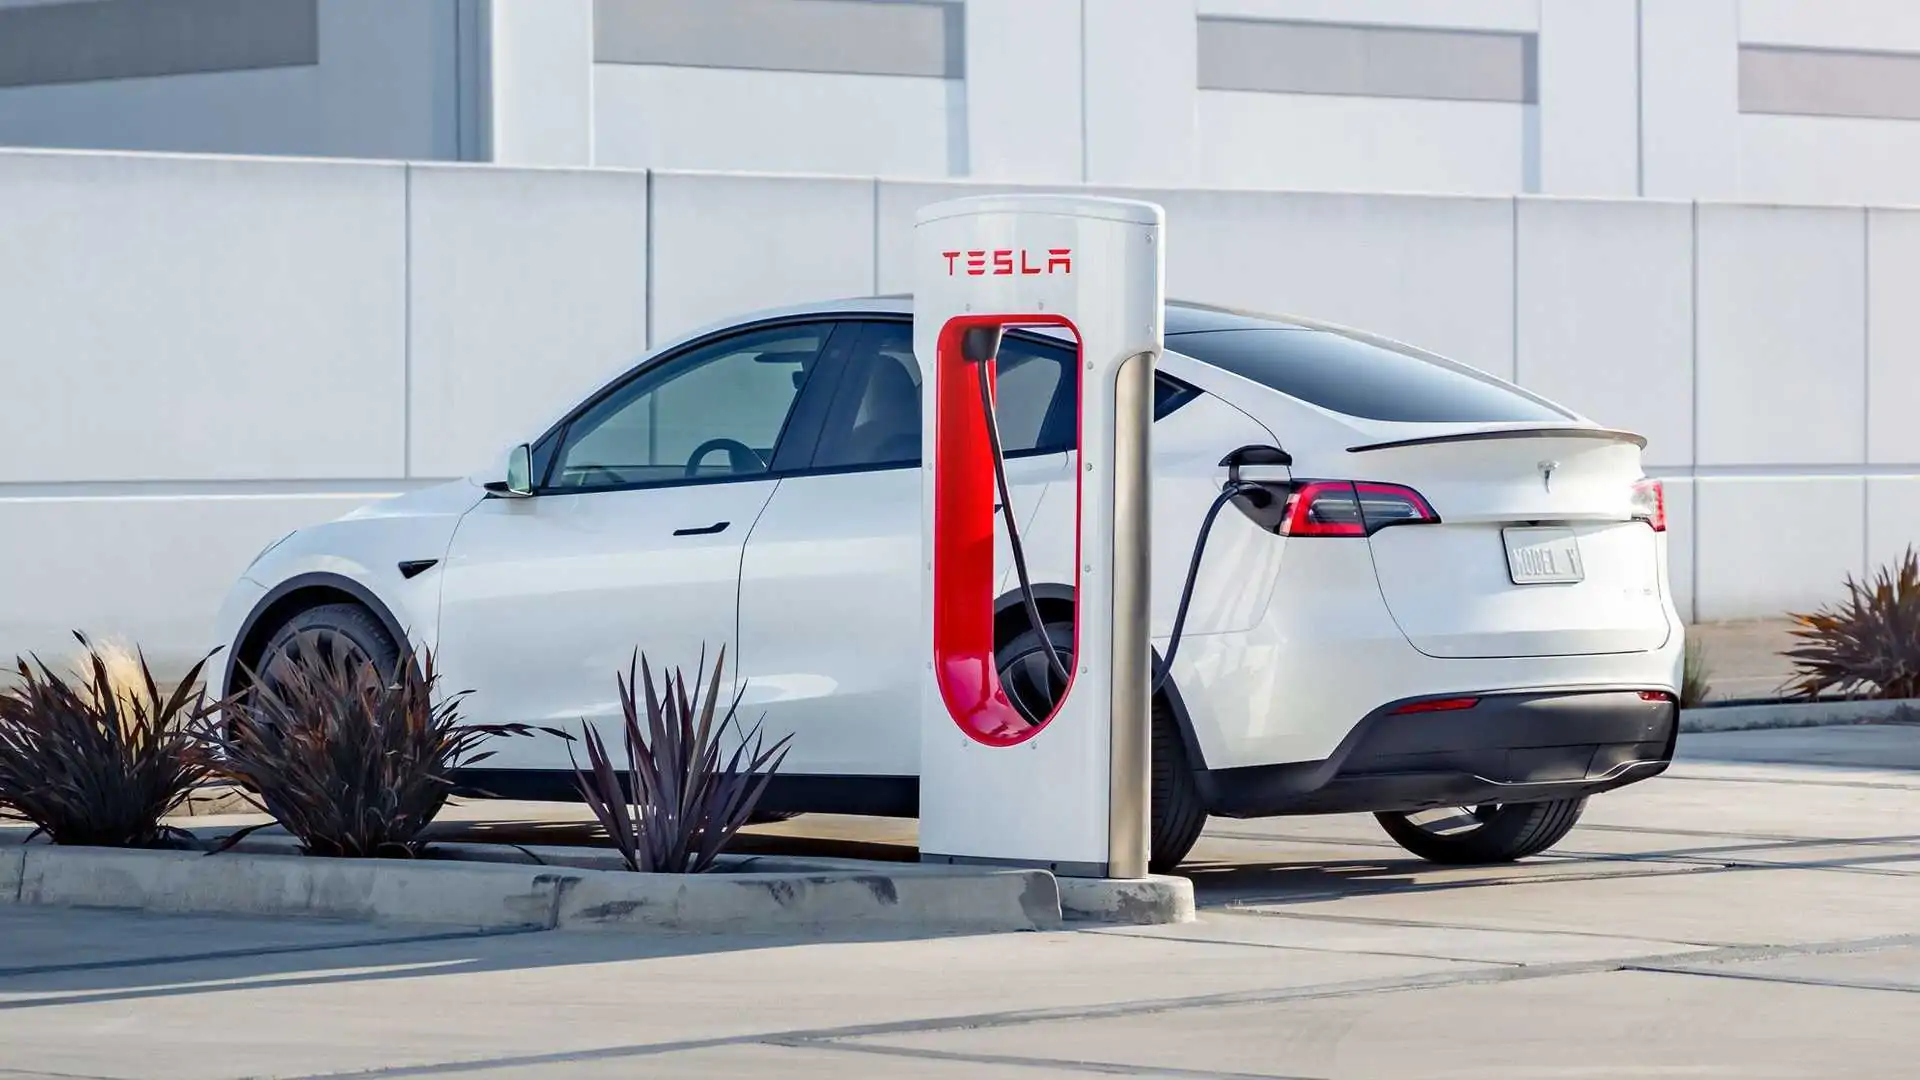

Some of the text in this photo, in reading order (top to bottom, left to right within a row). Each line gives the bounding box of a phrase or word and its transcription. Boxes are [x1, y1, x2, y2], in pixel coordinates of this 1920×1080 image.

[942, 249, 1071, 276] TESLA
[1513, 548, 1577, 576] MODEL Y
